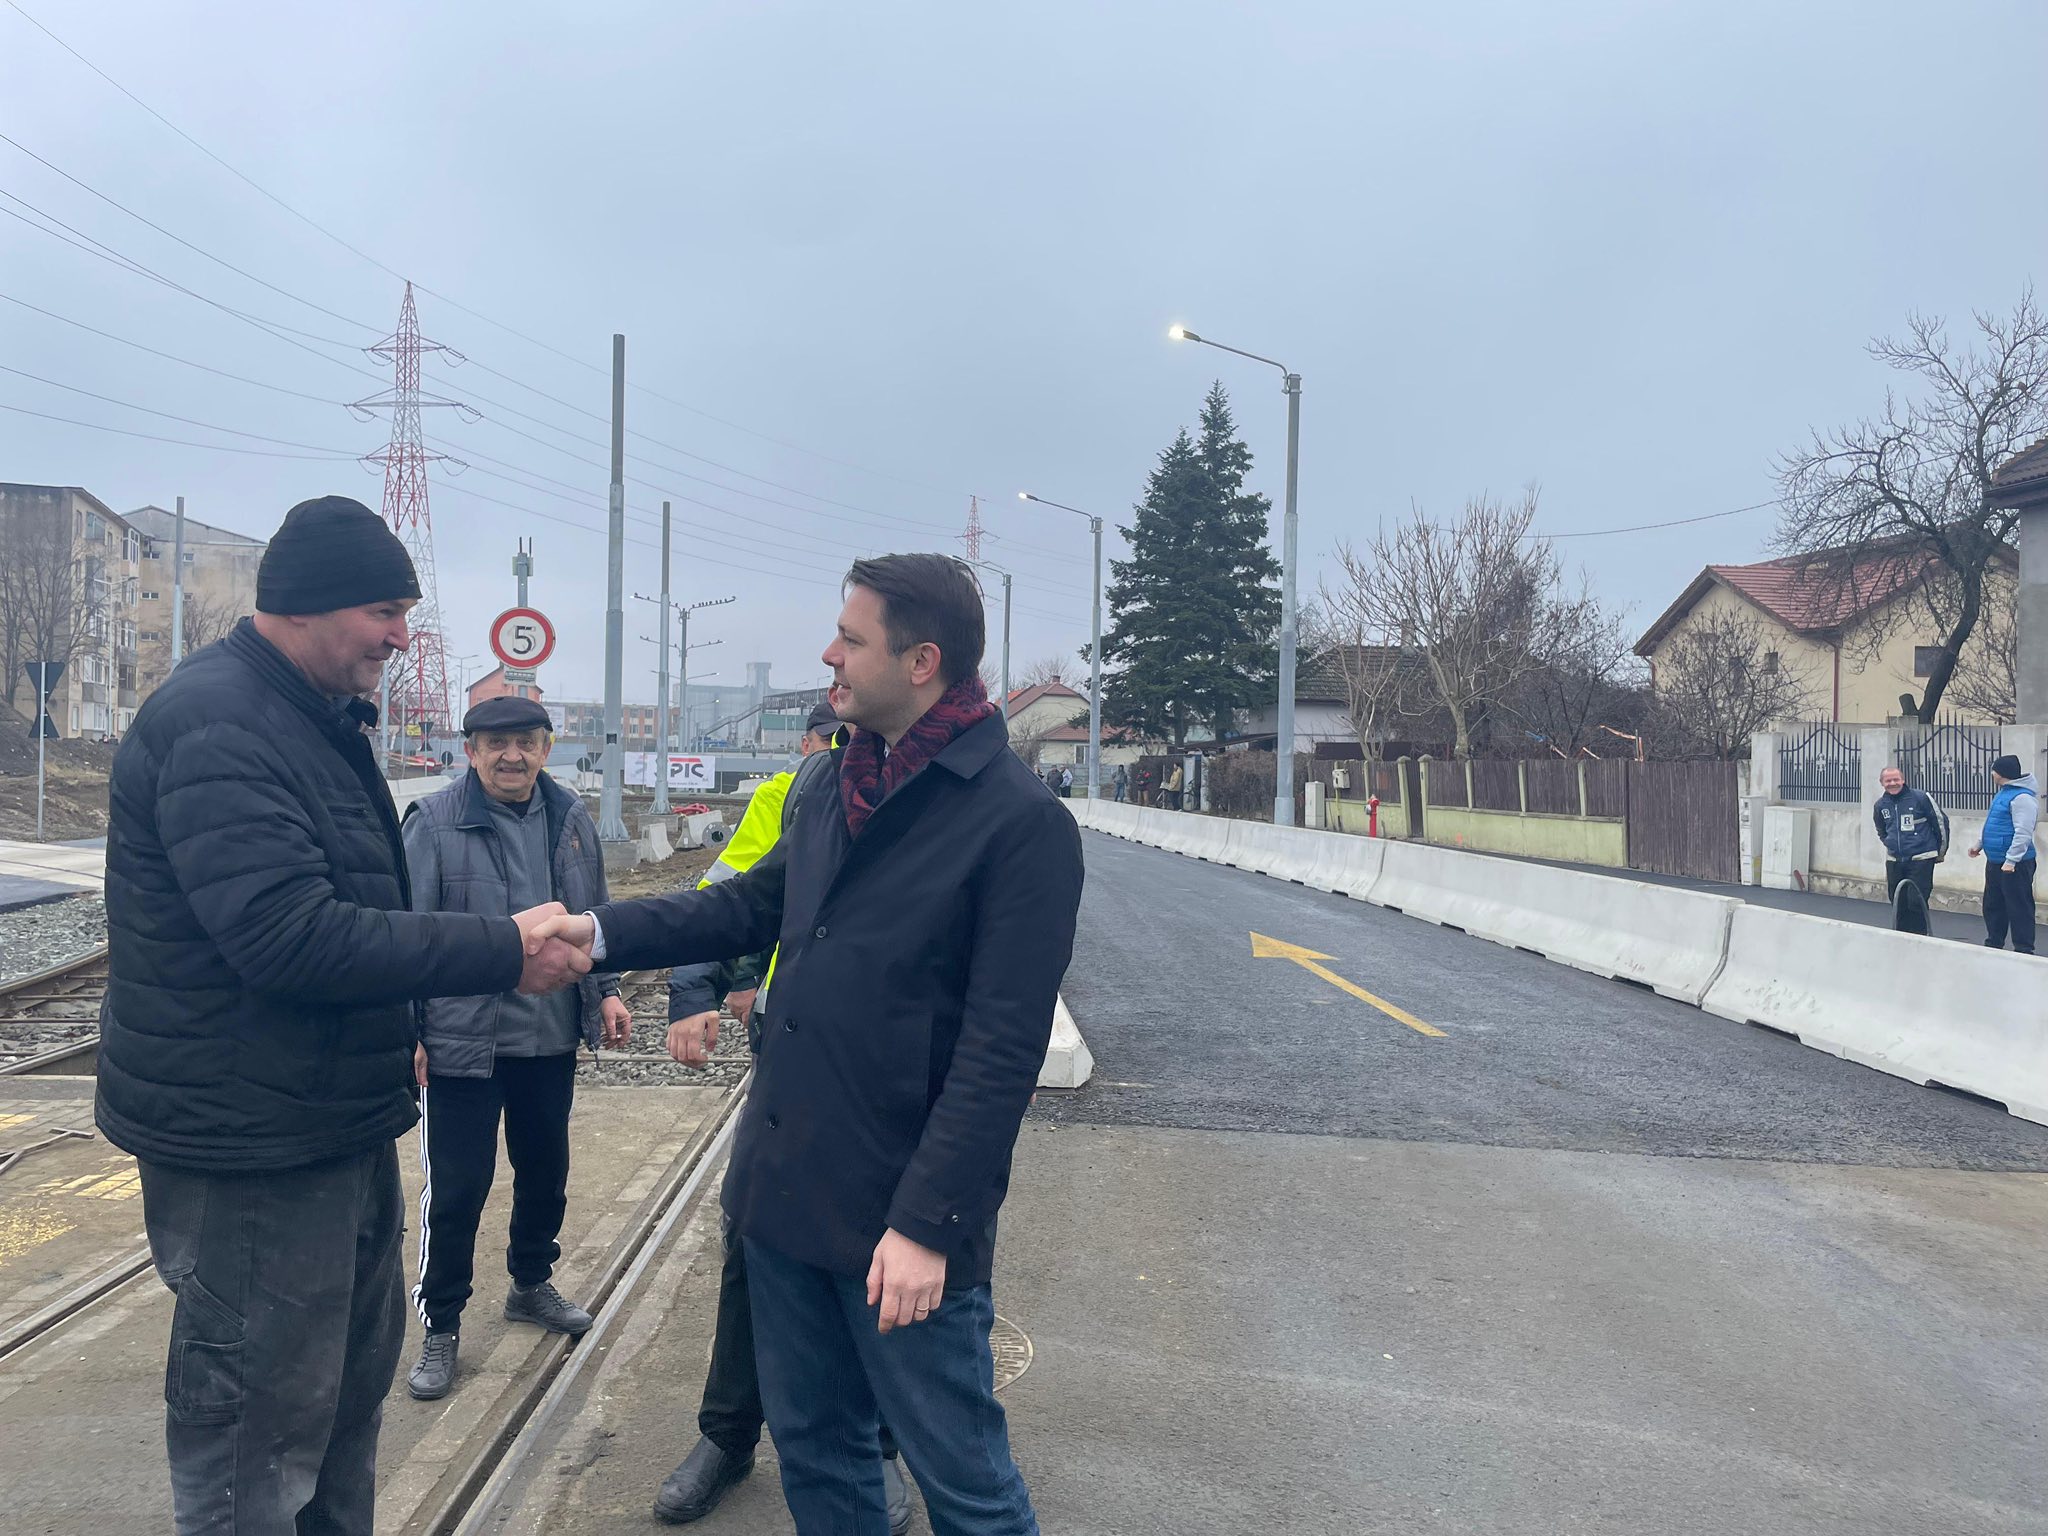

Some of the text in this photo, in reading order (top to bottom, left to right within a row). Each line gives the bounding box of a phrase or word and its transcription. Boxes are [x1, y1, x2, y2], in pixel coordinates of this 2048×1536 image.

[513, 625, 533, 654] 5
[654, 763, 704, 778] PIC
[1882, 809, 1890, 818] R
[1904, 816, 1911, 825] R
